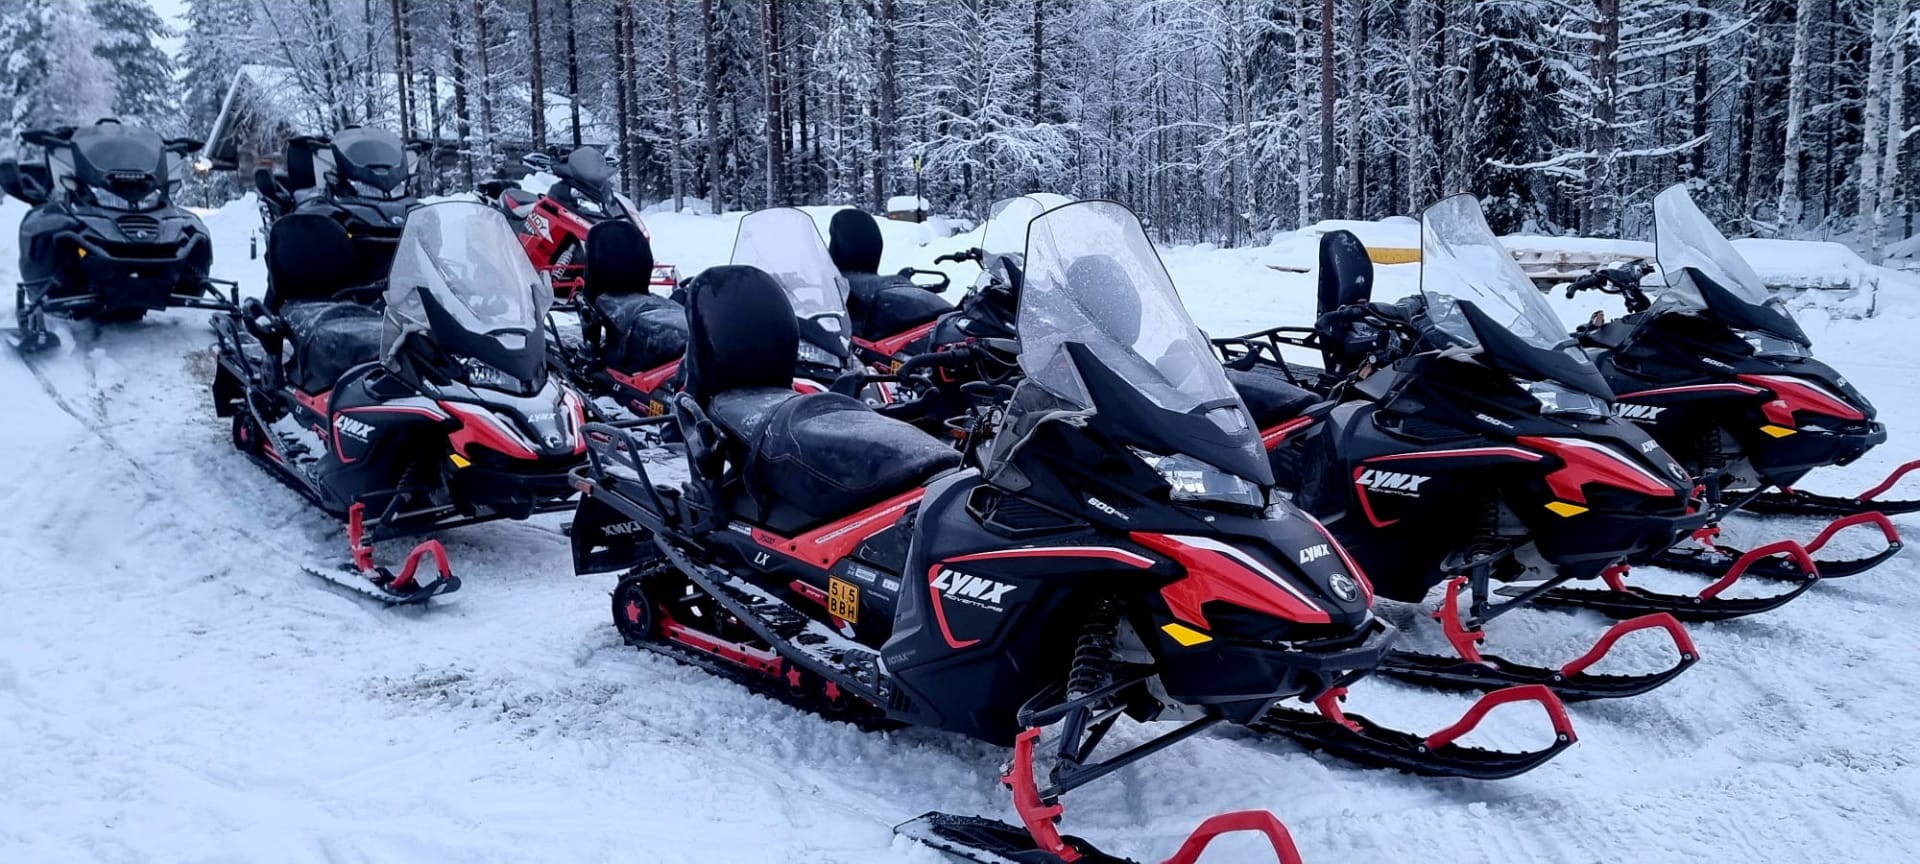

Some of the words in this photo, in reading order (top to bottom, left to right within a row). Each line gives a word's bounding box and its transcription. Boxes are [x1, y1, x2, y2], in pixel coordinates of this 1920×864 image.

[333, 415, 376, 439] LYNX
[528, 413, 556, 423] LYNX
[1355, 469, 1432, 492] LYNX
[1088, 497, 1115, 515] 600
[754, 551, 771, 567] LX
[1300, 544, 1331, 565] LYNX
[930, 569, 1018, 604] LYNX
[831, 598, 855, 619] BBH
[943, 593, 1003, 612] ADVENTURE
